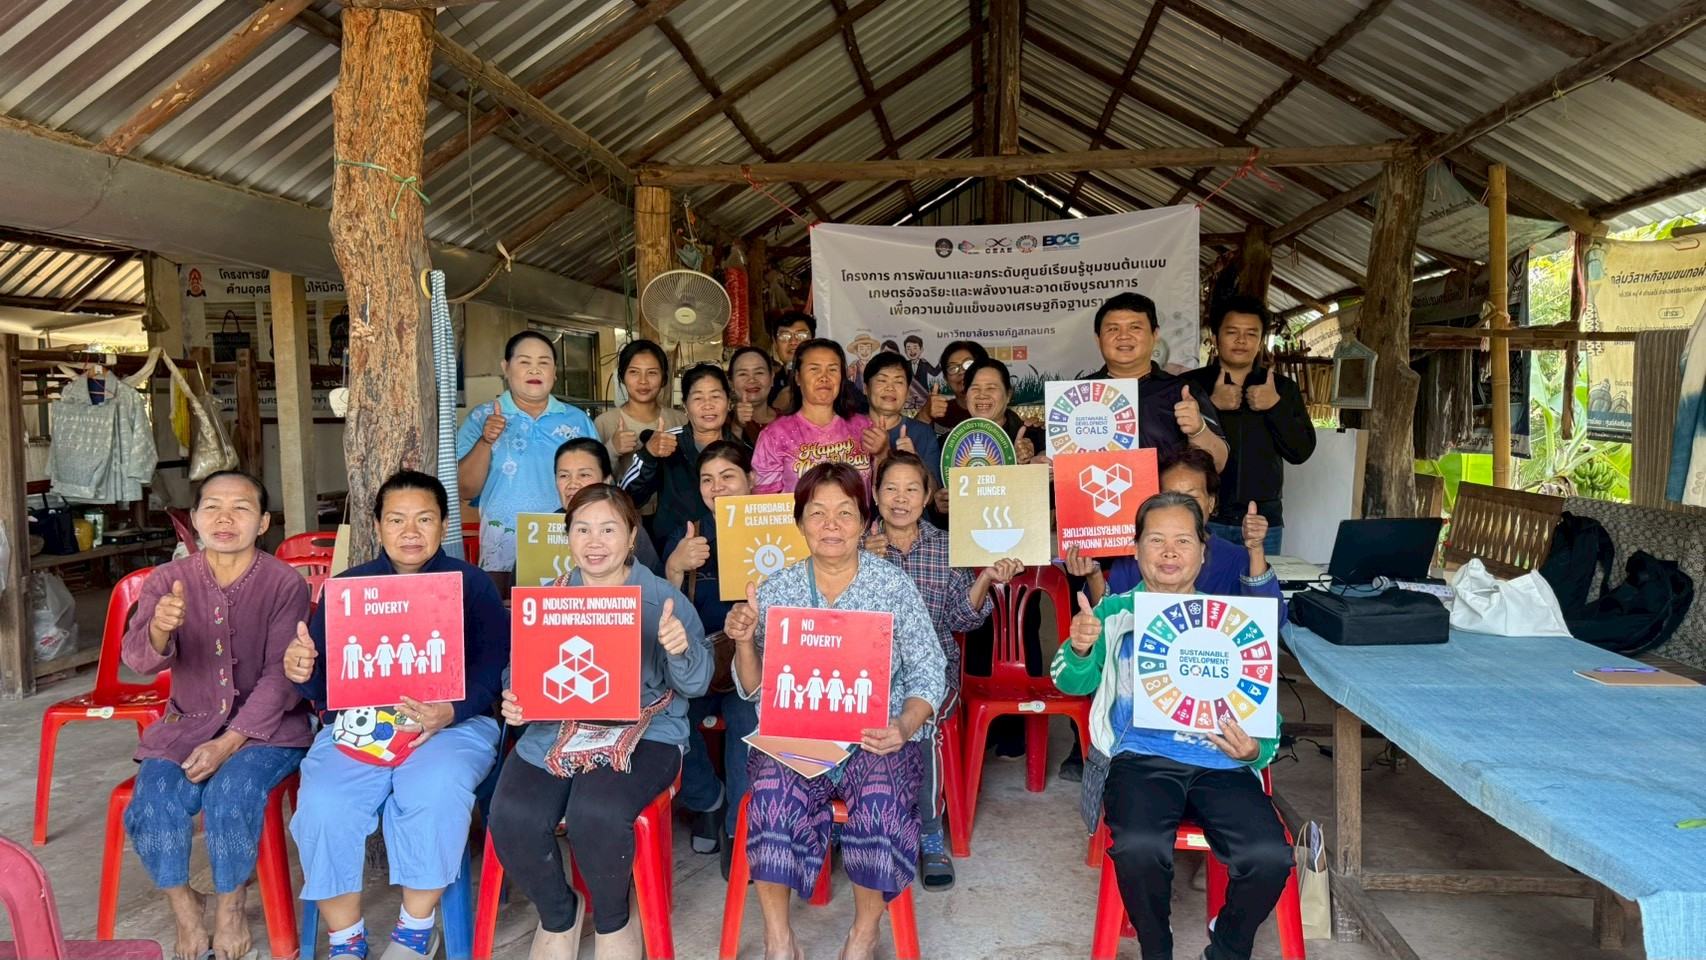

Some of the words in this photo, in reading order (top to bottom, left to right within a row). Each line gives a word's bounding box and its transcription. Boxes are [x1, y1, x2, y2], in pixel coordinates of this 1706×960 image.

[1042, 232, 1080, 246] BCG
[219, 268, 269, 280] โครงการฝึ
[841, 269, 890, 282] โครงการ
[1611, 262, 1706, 287] กลุ่มวิสาหกิจชุมชนทอผ
[226, 284, 271, 297] ด้านอุตส
[305, 281, 344, 293] ให้มีคว
[868, 277, 1138, 298] เกษตรอัจฉริยะและพลังงานสะอาดเชิงบูรณาการ
[890, 297, 1109, 315] เพื่อความเข้มแข็งของเศรษฐกิจฐานรา
[936, 326, 1056, 339] มหาวิทยาลัยราชภัฏสกลนคร
[1075, 426, 1108, 435] GOALS
[798, 439, 854, 460] Happy
[959, 475, 969, 497] 2
[977, 474, 996, 485] ZERO
[977, 485, 1006, 496] HUNGER
[744, 502, 791, 514] AFFORDABLE
[725, 505, 736, 528] 7
[744, 515, 769, 527] CLEAN
[769, 514, 795, 525] ENERG
[527, 521, 539, 544] 2
[1062, 524, 1121, 538] INFRASTRUCTURE
[547, 534, 569, 545] HUNG
[1102, 536, 1135, 548] NDUSTRY,
[364, 587, 378, 600] NO
[341, 588, 351, 616] 1
[364, 600, 409, 615] POVERTY
[542, 597, 586, 611] INDUSTRY,
[586, 597, 637, 610] INNOVATION
[522, 597, 537, 626] 9
[542, 613, 561, 626] AND
[561, 612, 635, 625] INFRASTRUCTURE
[801, 619, 814, 631] NO
[780, 617, 790, 645] 1
[800, 634, 842, 648] POVERTY
[1179, 649, 1230, 658] SUSTAINABLE
[1179, 656, 1230, 665] DEVELOPMENT
[1179, 664, 1229, 679] GOALS
